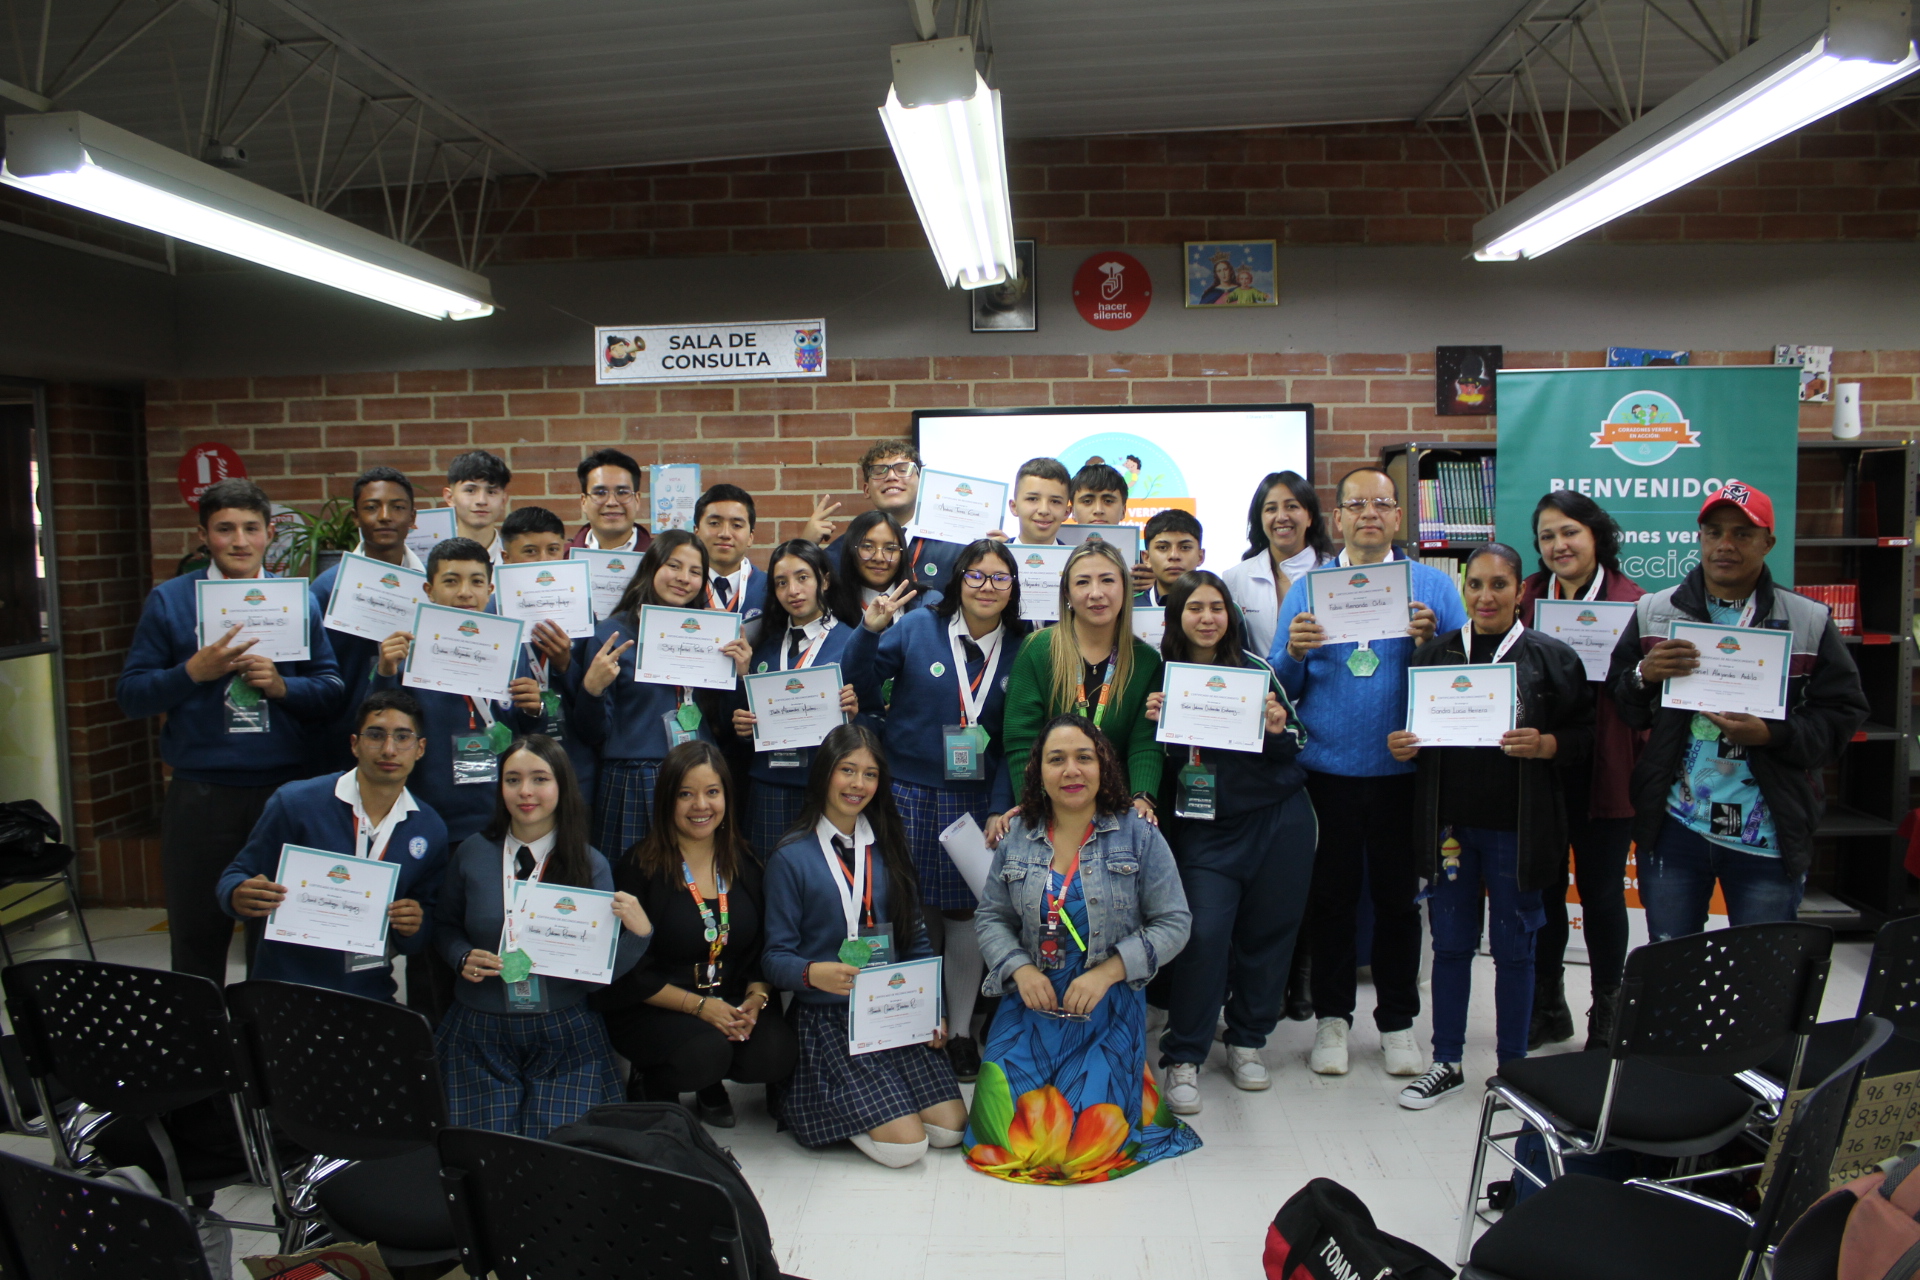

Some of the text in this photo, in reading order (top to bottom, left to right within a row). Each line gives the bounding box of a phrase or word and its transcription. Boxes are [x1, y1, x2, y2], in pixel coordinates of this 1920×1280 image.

[1093, 310, 1132, 320] silencio
[1098, 302, 1127, 311] hacer
[669, 332, 756, 350] SALA DE
[661, 352, 771, 370] CONSULTA
[1550, 477, 1740, 498] BIENVENIDO
[1666, 530, 1701, 543] ver
[1619, 549, 1702, 578] cció
[1431, 706, 1451, 714] Sandra
[1686, 739, 1703, 775] adidas
[1867, 1082, 1912, 1101] 96 95
[1855, 1109, 1878, 1128] 83
[1880, 1105, 1901, 1125] 84
[1846, 1139, 1864, 1153] 76
[1873, 1135, 1891, 1149] 75
[1320, 1236, 1361, 1280] TOMM
